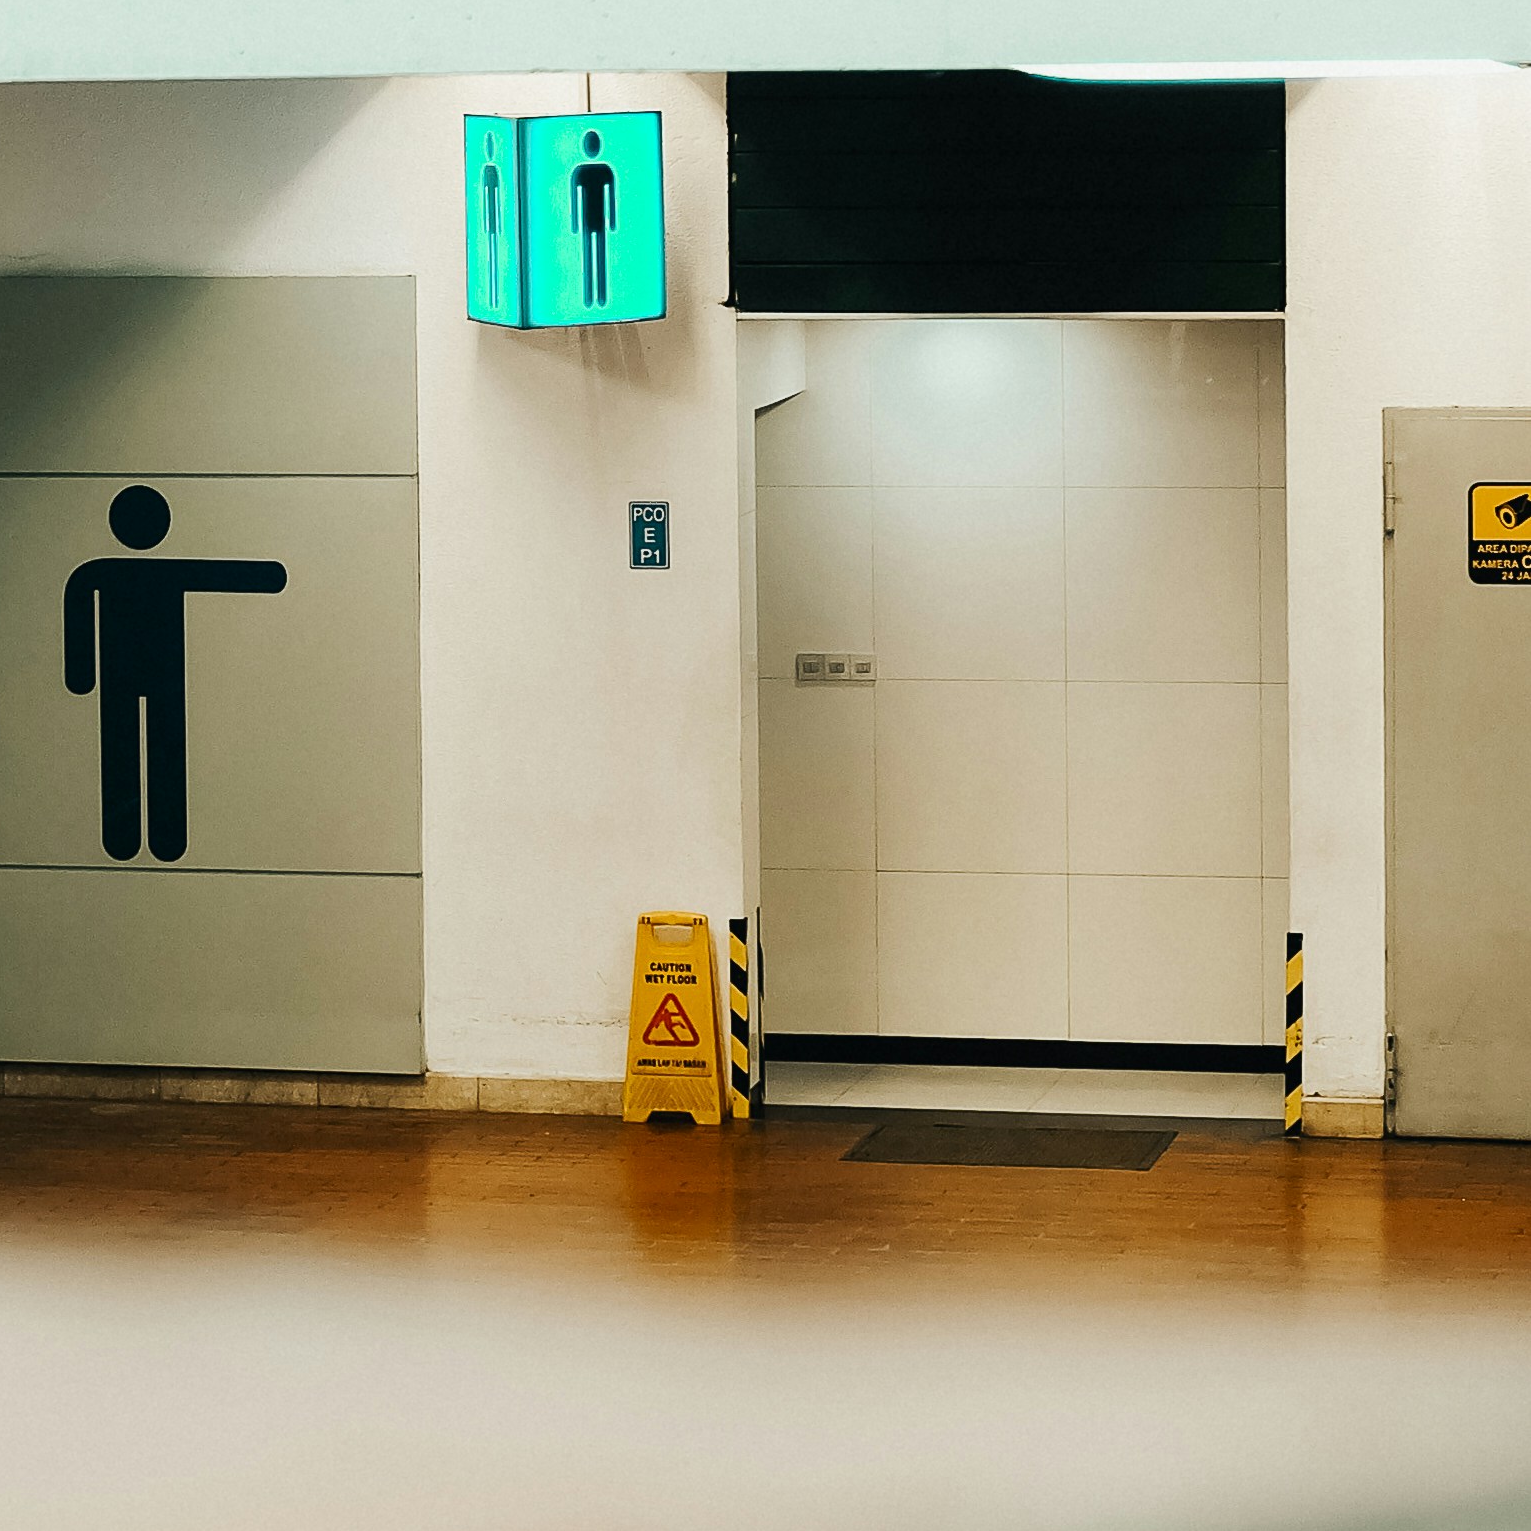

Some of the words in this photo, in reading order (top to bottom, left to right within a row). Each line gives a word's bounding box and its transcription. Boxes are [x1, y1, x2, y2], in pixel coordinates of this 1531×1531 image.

[633, 507, 665, 522] PCO
[644, 527, 656, 543] E
[1478, 544, 1508, 553] AREA
[1510, 544, 1531, 553] DIP
[640, 548, 660, 564] P1
[1472, 560, 1519, 568] KAMERA
[1501, 571, 1514, 580] 24
[650, 962, 692, 972] CAUTION
[645, 974, 665, 984] WET
[667, 974, 698, 985] FLOOR
